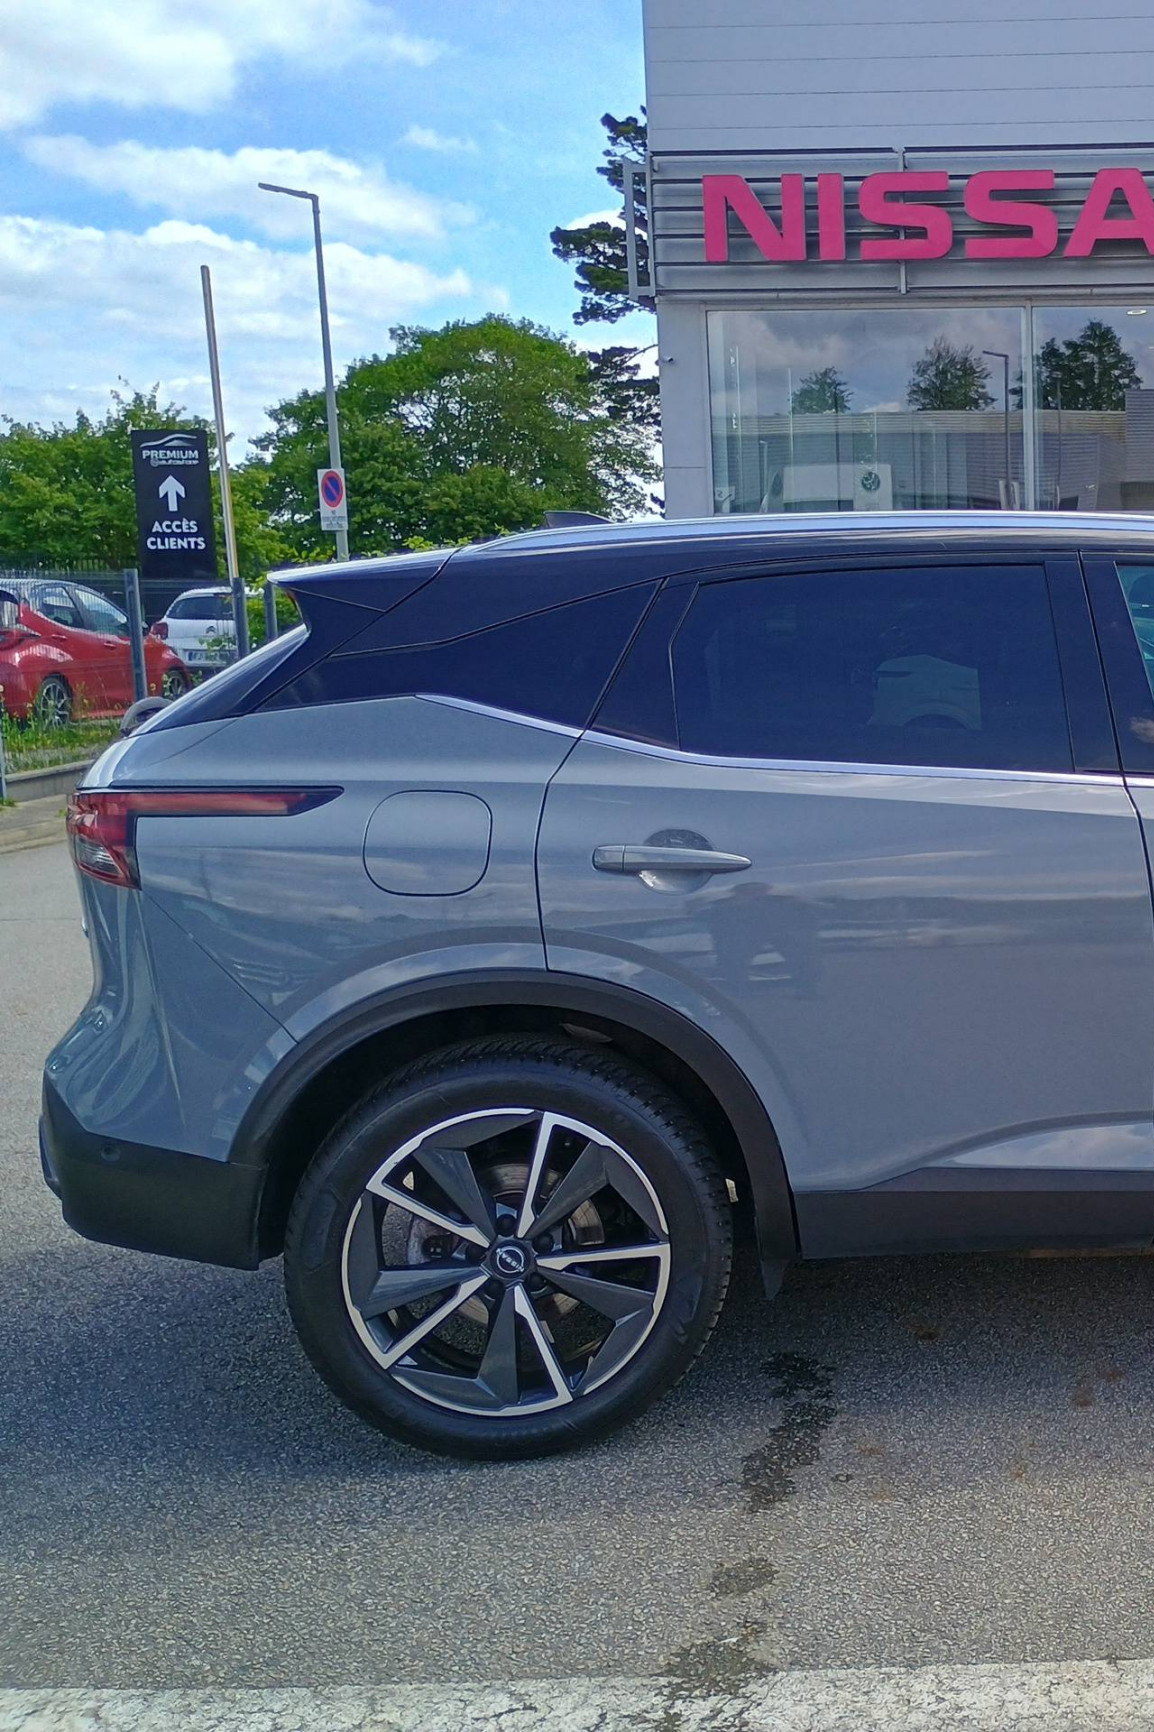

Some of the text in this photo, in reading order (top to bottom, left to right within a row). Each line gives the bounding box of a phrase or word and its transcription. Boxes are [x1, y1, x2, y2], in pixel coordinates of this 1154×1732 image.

[142, 450, 199, 459] PREMIUM
[151, 518, 198, 533] ACCÈS
[146, 537, 206, 550] CLIENTS
